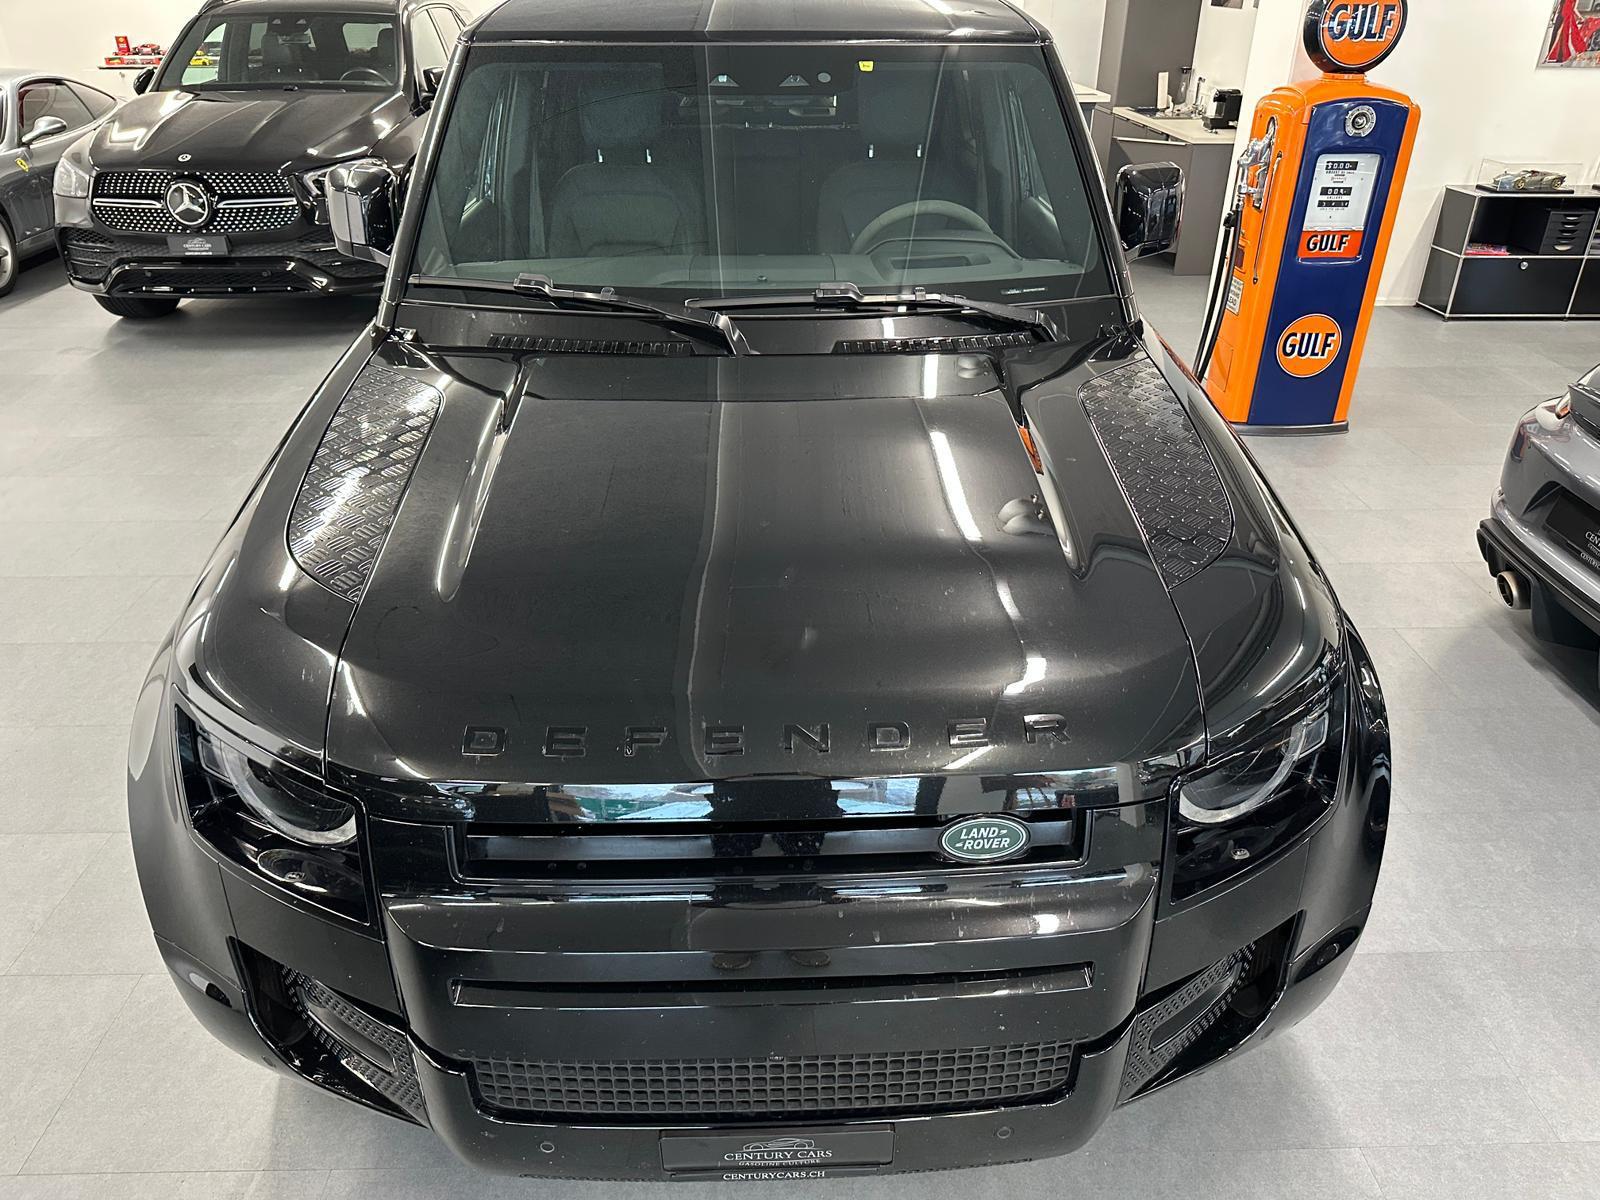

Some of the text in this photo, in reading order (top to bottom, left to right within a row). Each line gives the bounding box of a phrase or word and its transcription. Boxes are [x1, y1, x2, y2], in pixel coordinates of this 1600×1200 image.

[1329, 4, 1397, 42] GULF
[1307, 235, 1350, 252] GULF
[1282, 332, 1337, 359] GULF
[462, 713, 1072, 758] DEFENDER
[724, 1150, 833, 1160] CENTURY CARS
[723, 1171, 825, 1180] CENTURYCARS.CH
